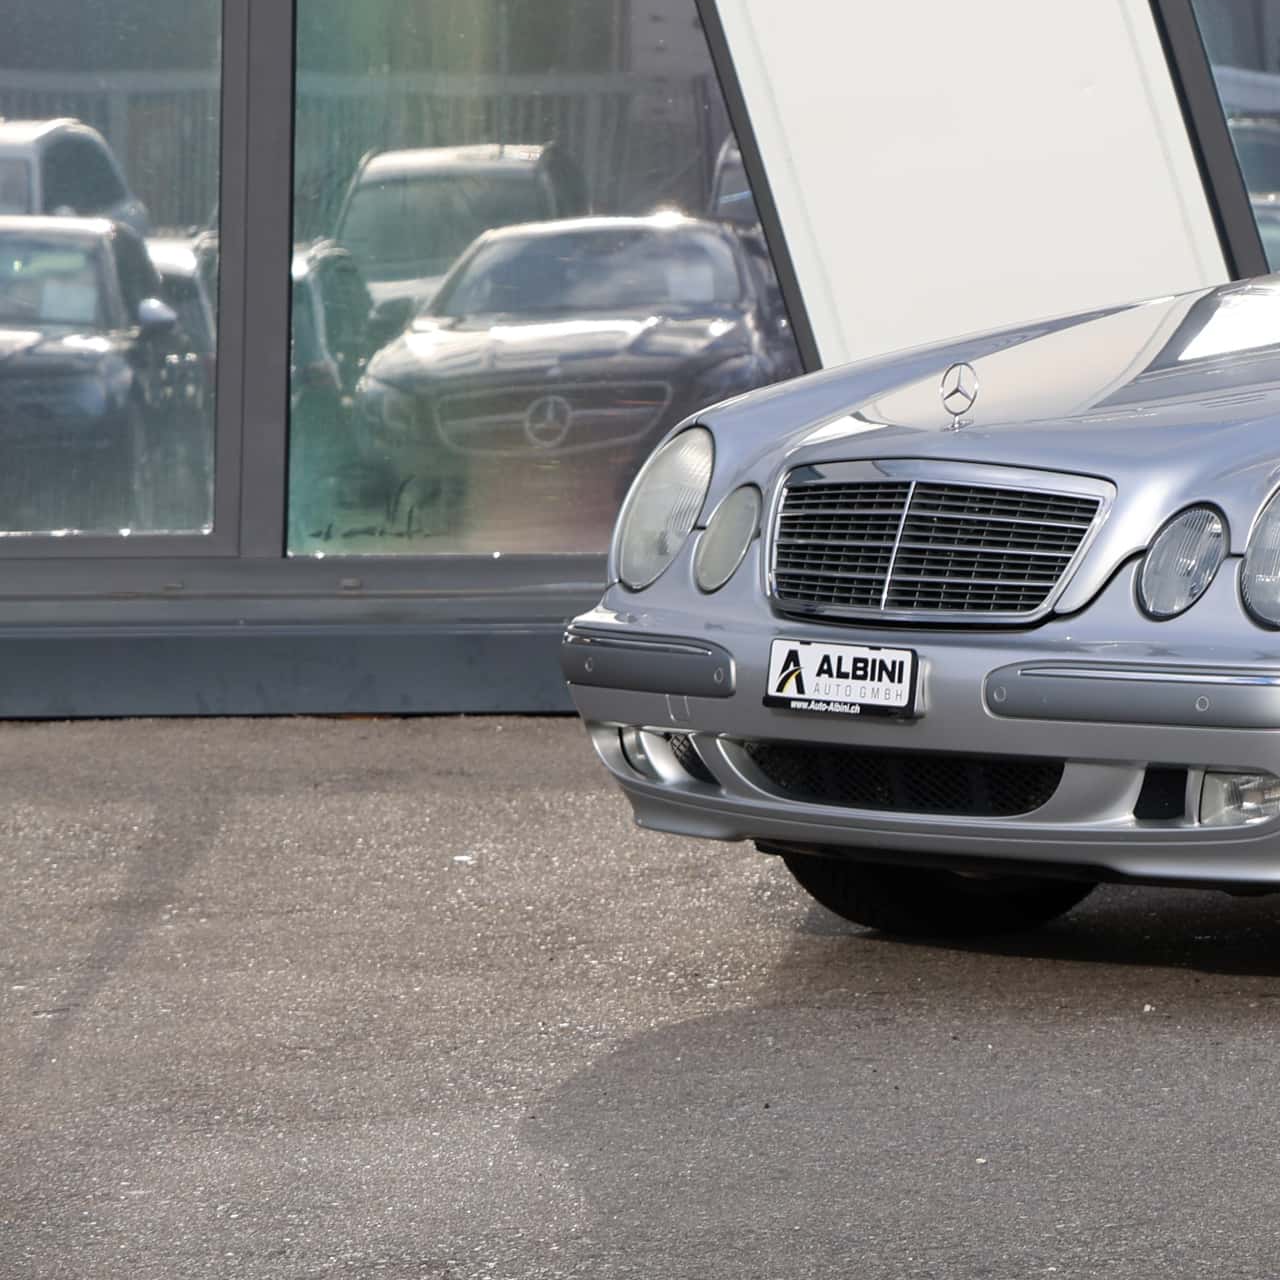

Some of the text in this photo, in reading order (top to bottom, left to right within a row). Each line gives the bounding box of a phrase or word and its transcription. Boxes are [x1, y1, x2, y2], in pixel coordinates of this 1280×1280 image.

[815, 654, 904, 684] ALBINI
[812, 682, 904, 702] AUTO GMBH
[790, 700, 861, 714] www.Auto-Albini.ch
